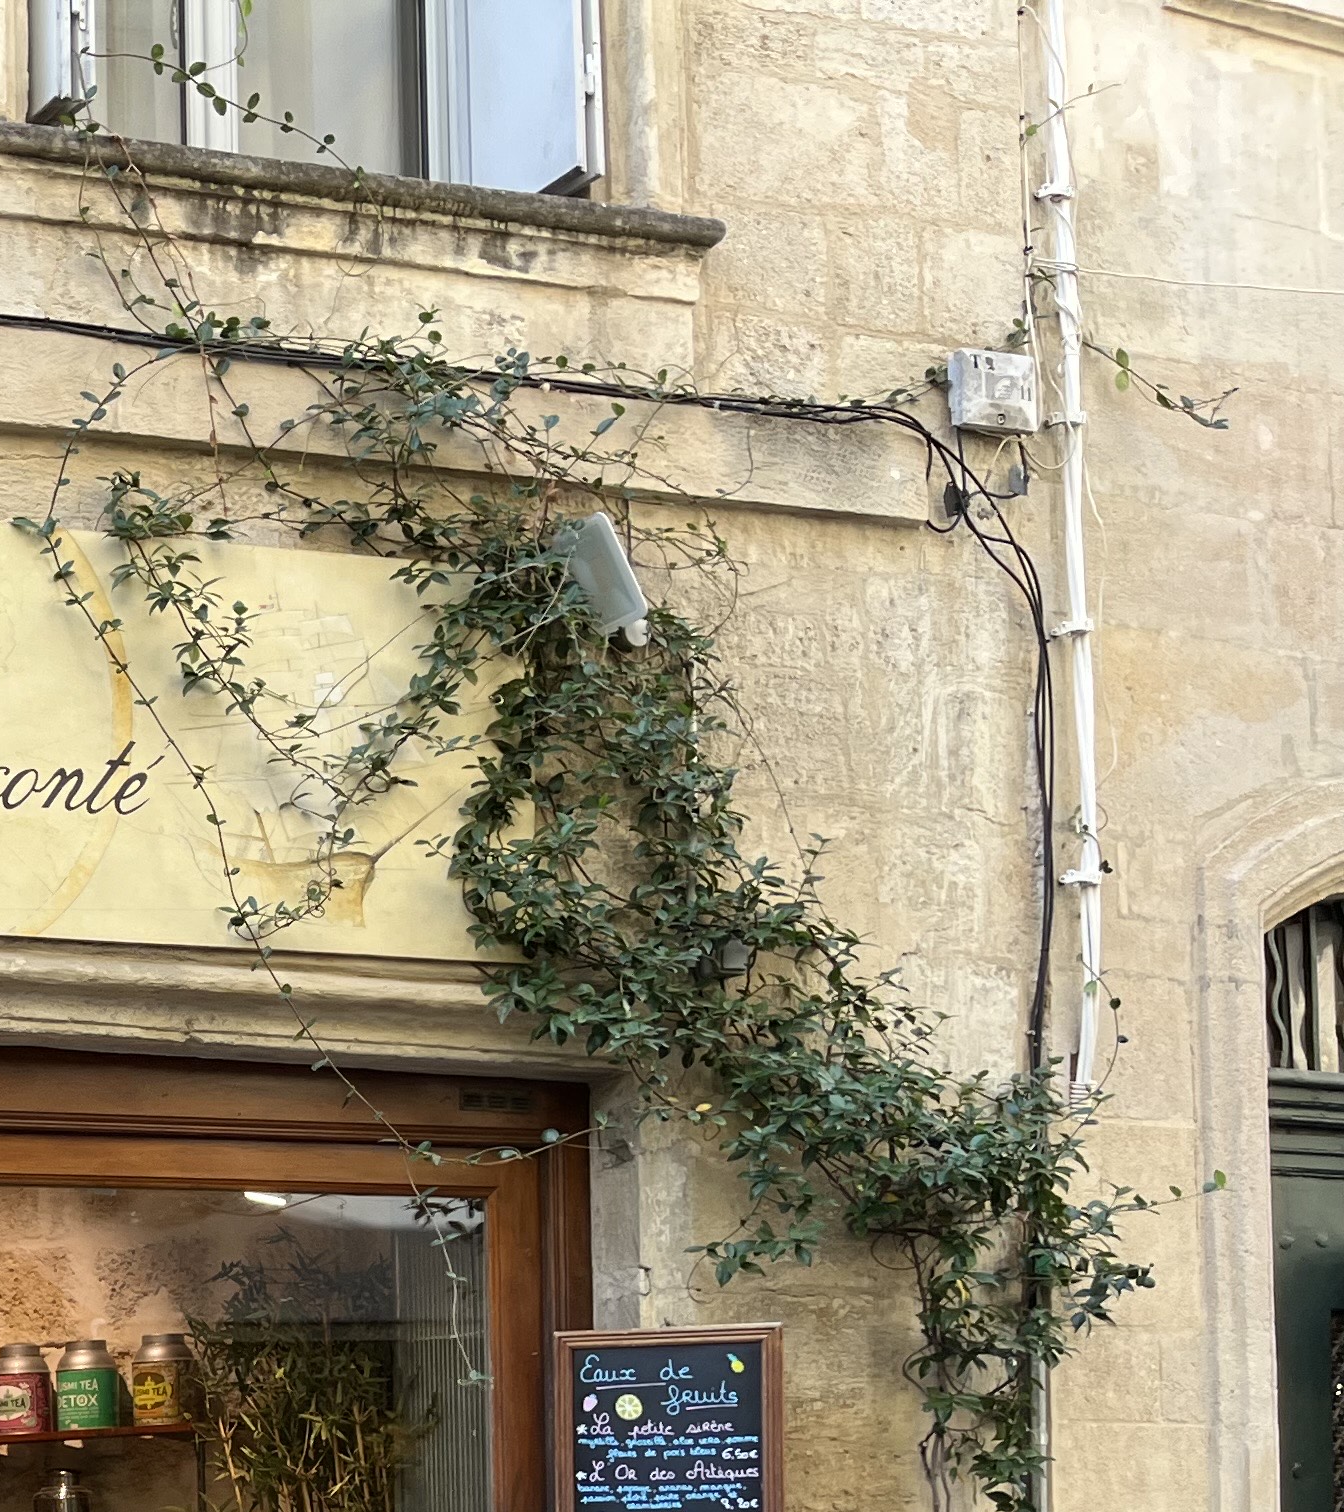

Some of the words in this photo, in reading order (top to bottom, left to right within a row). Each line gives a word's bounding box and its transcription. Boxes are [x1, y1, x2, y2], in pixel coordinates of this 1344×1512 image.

[580, 1354, 637, 1383] Eaux
[660, 1359, 694, 1380] de
[80, 1378, 98, 1390] TEA
[152, 1387, 167, 1396] TEA
[661, 1380, 738, 1415] fruits
[10, 1399, 26, 1408] TEA
[590, 1412, 614, 1435] La
[628, 1419, 675, 1438] petite
[650, 1467, 676, 1479] des
